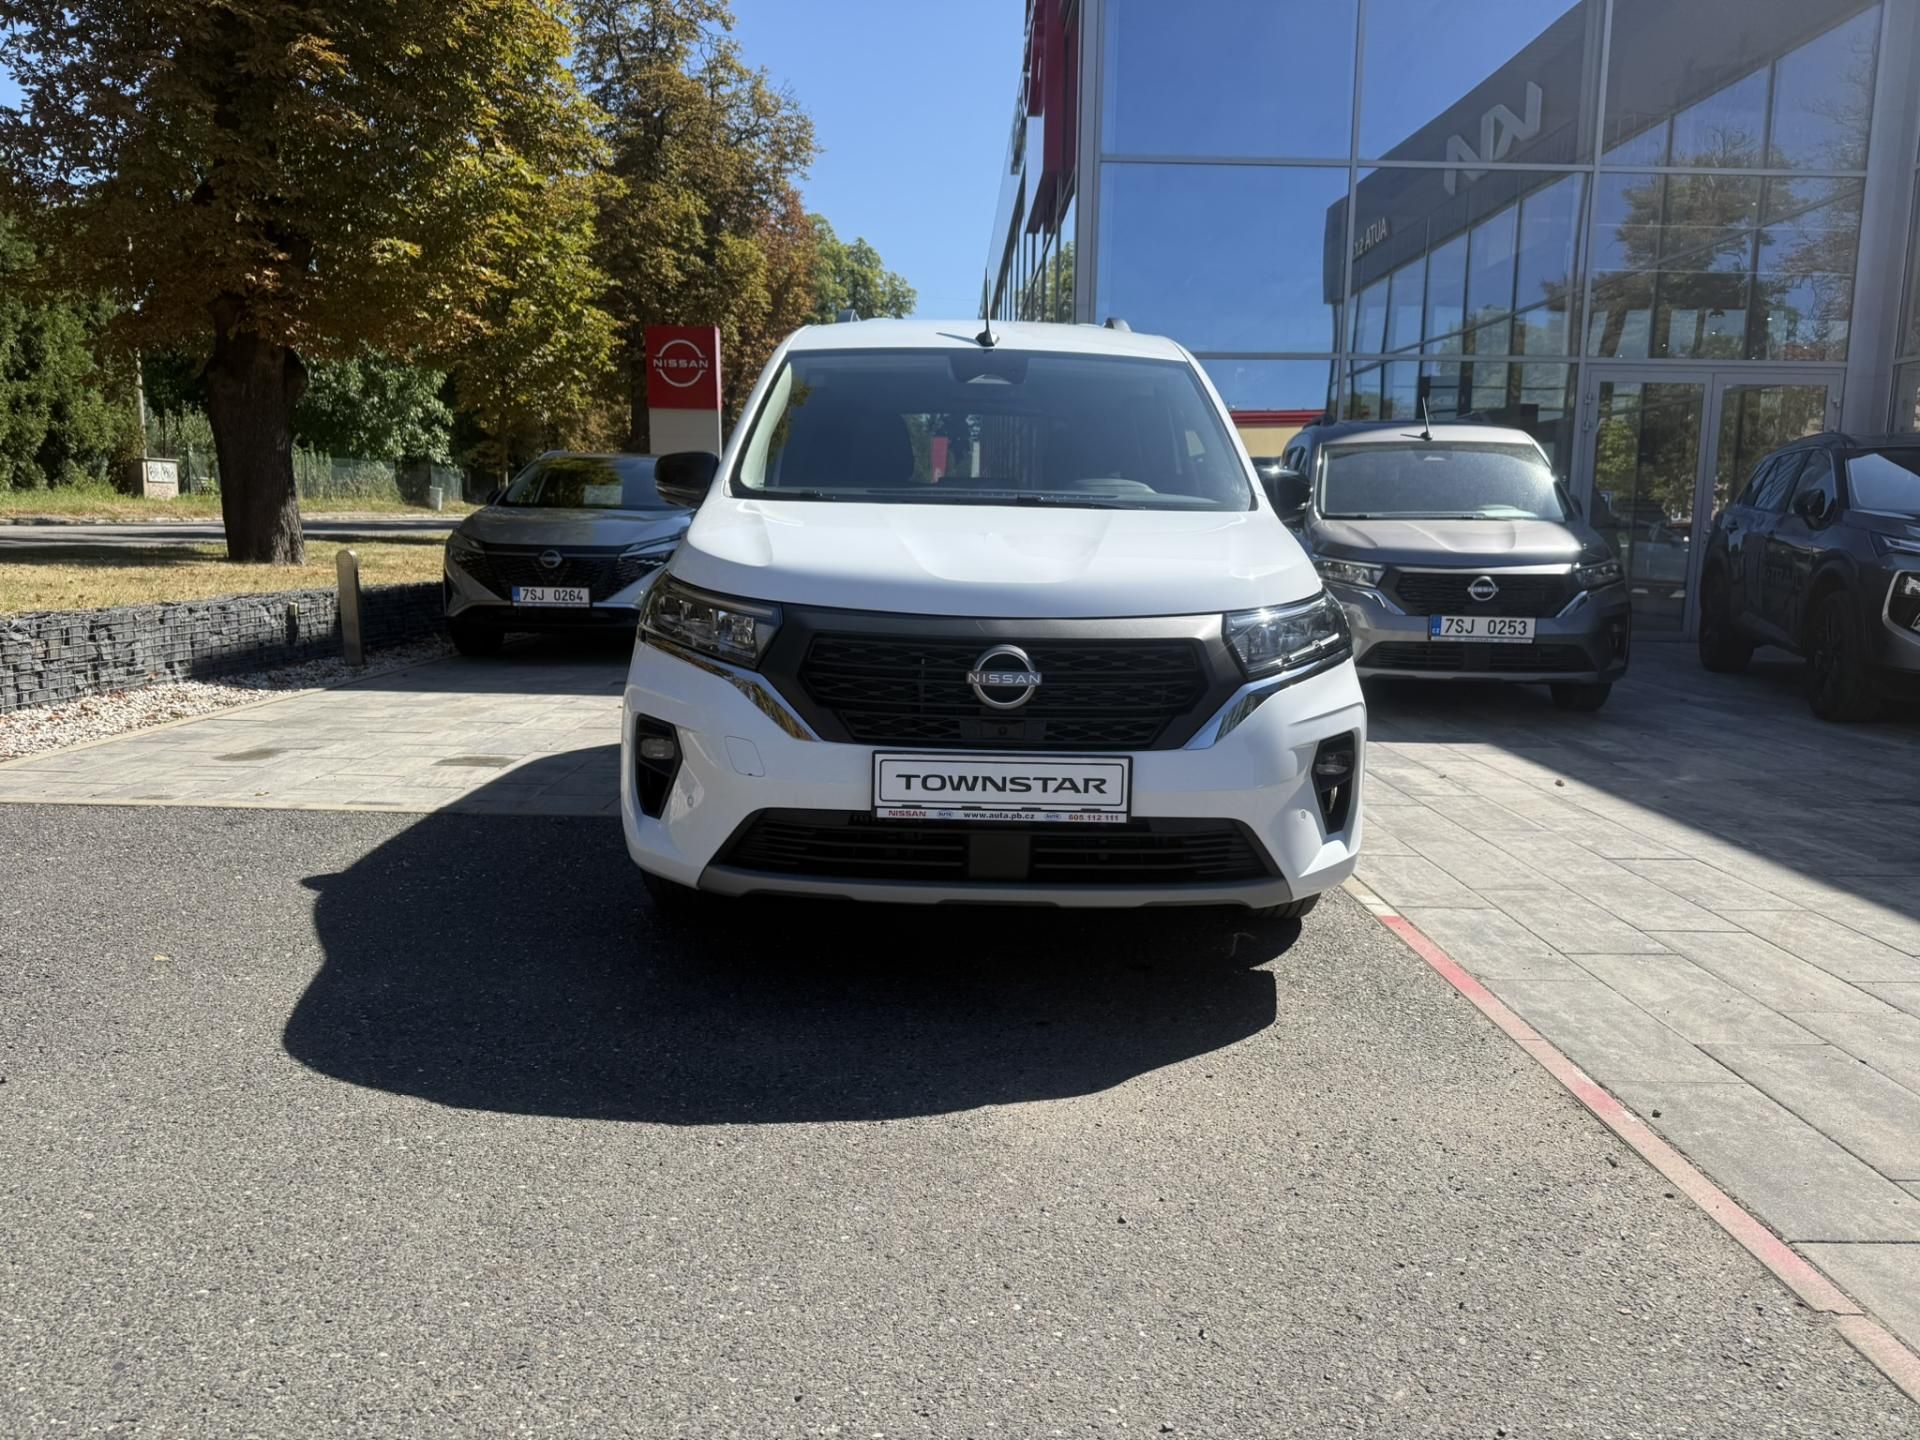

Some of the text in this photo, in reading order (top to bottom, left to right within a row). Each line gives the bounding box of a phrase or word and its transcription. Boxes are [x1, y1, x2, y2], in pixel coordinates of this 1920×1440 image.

[653, 359, 709, 368] NISSAN
[522, 588, 545, 601] 7SJ
[553, 589, 584, 602] 0264
[1445, 618, 1527, 635] 7SJ 0253
[968, 673, 1041, 684] NISSAN
[896, 774, 1107, 794] TOWNSTAR
[888, 809, 927, 818] NISSAN
[963, 811, 1035, 821] www.auta.pb.cz
